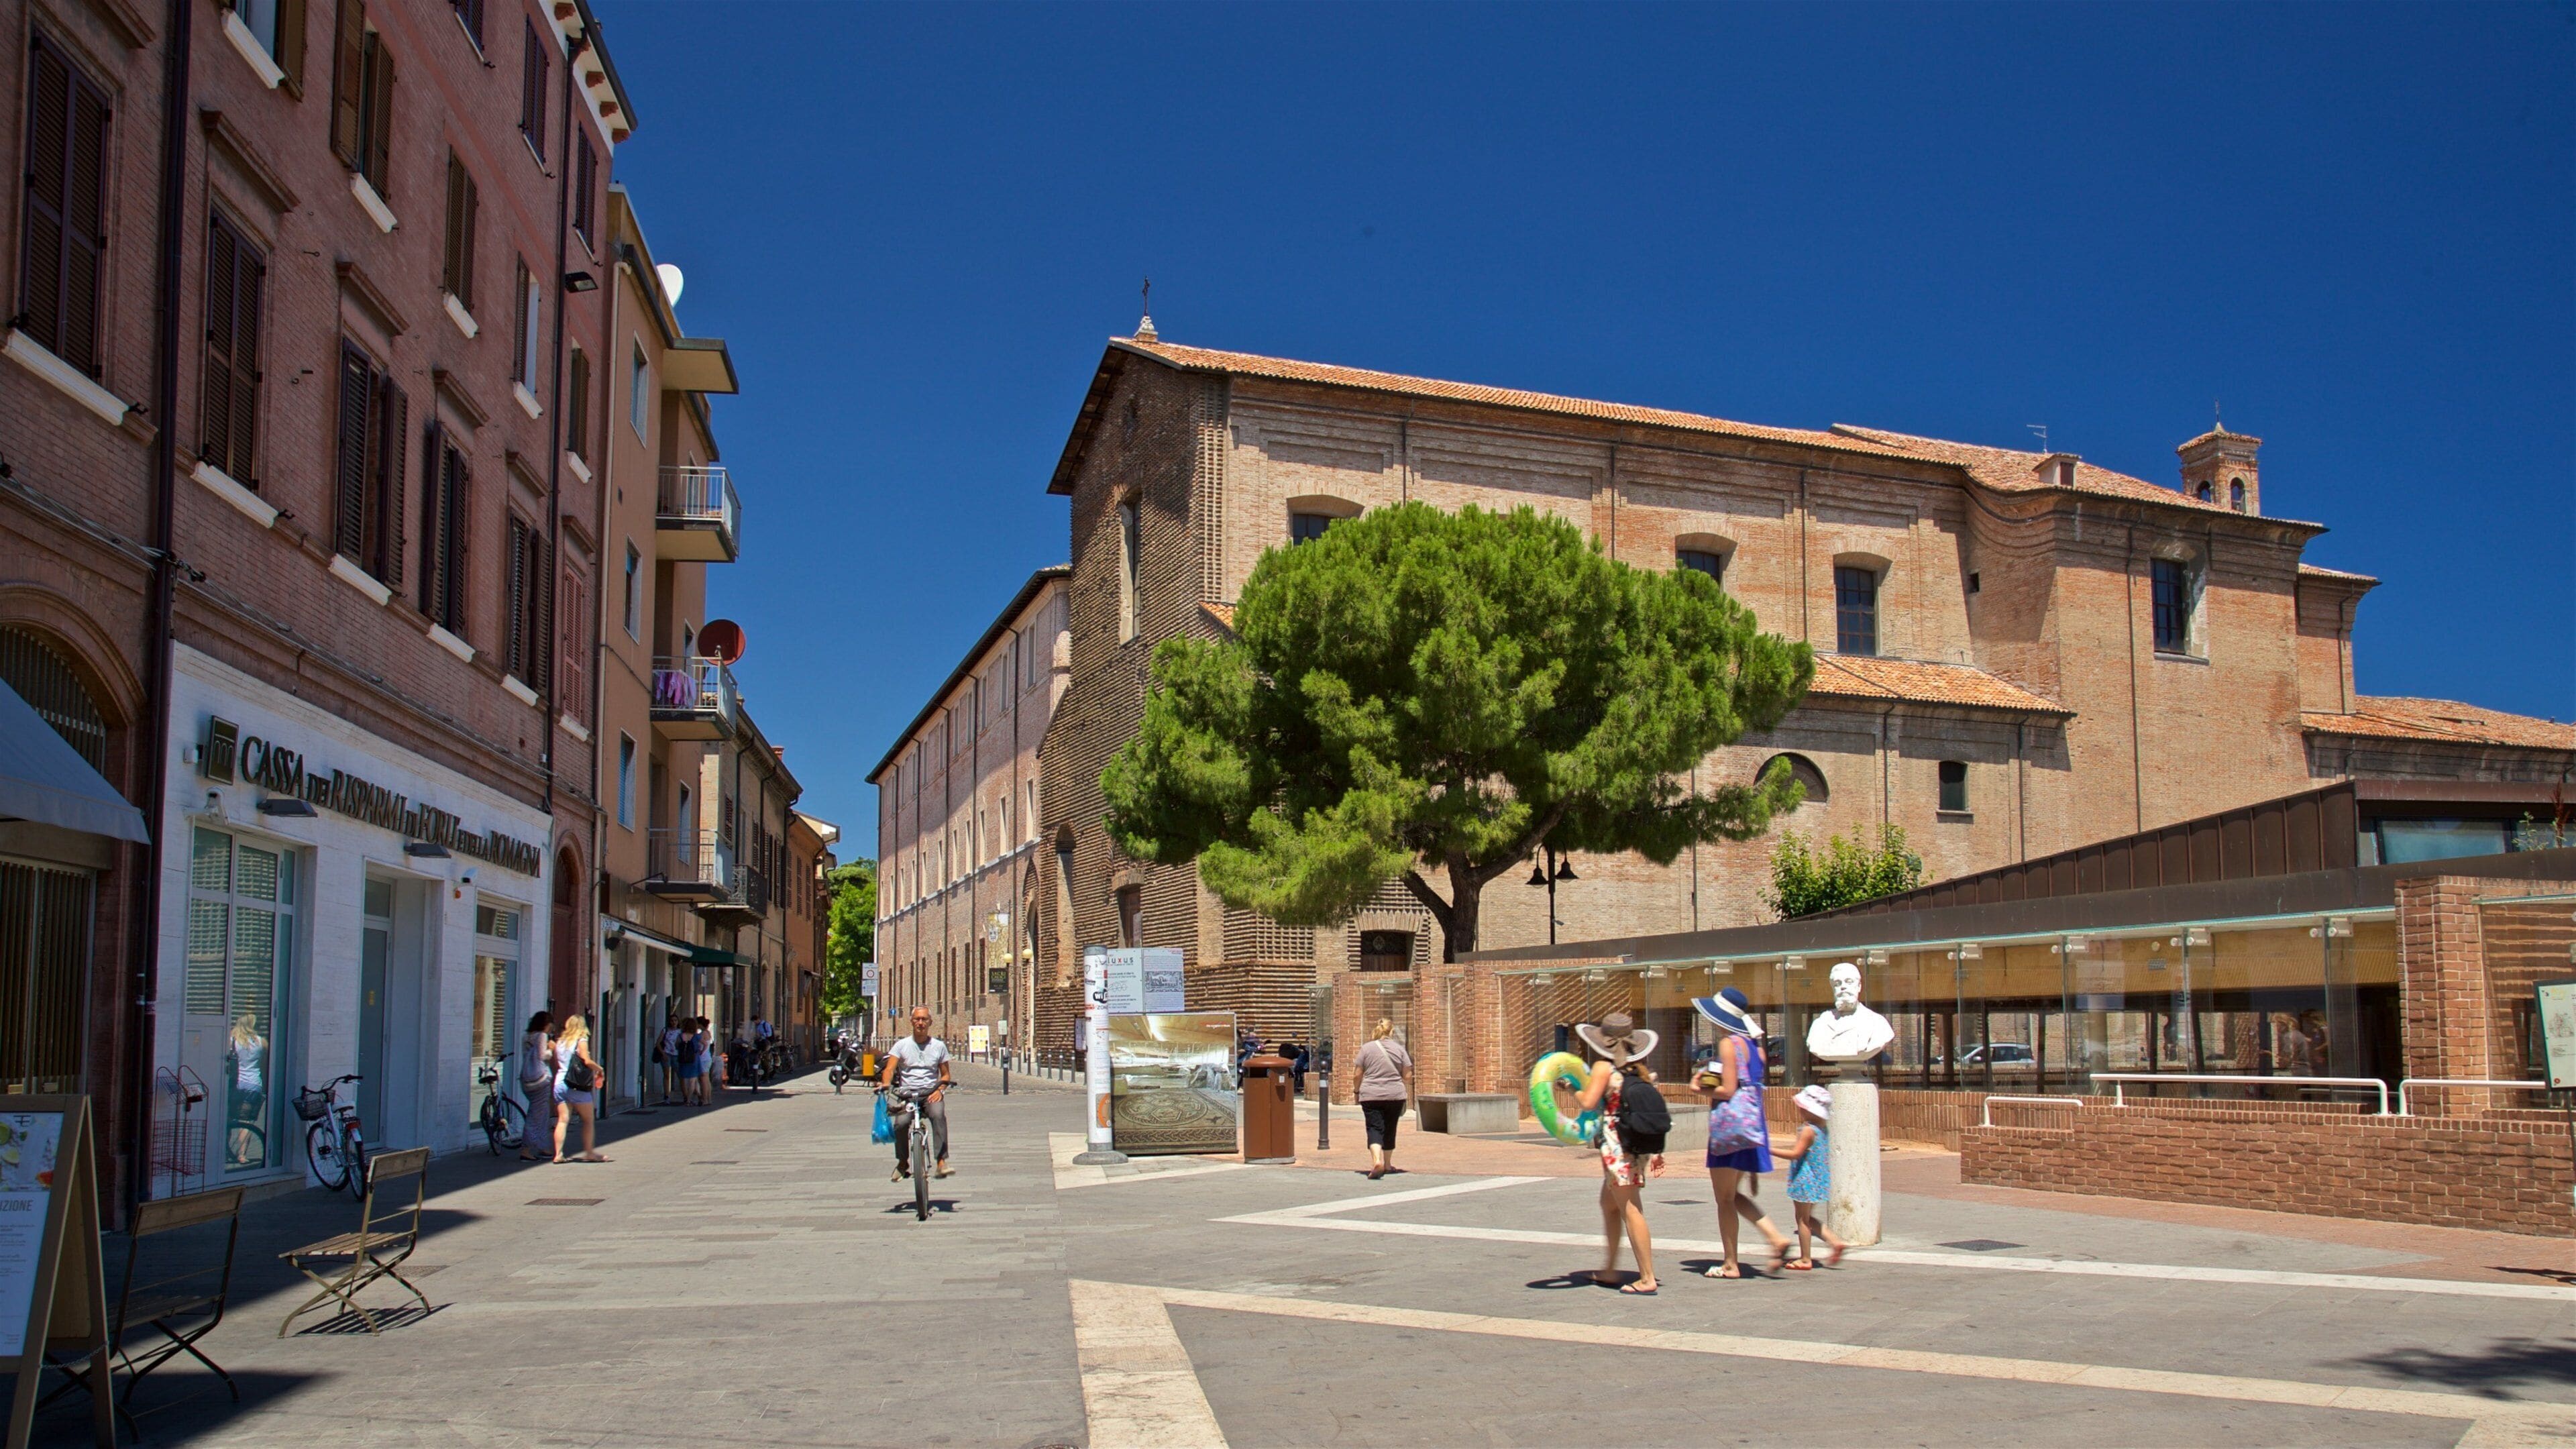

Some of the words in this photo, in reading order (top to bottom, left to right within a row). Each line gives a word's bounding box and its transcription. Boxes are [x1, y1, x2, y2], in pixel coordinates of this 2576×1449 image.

[241, 736, 305, 800] CASSA
[307, 773, 331, 805] DEI
[330, 768, 407, 833] RISPARMI
[405, 810, 418, 839] DI
[465, 830, 490, 861] DELLA
[488, 830, 540, 878] ROMAGNA
[1108, 956, 1134, 964] luxus
